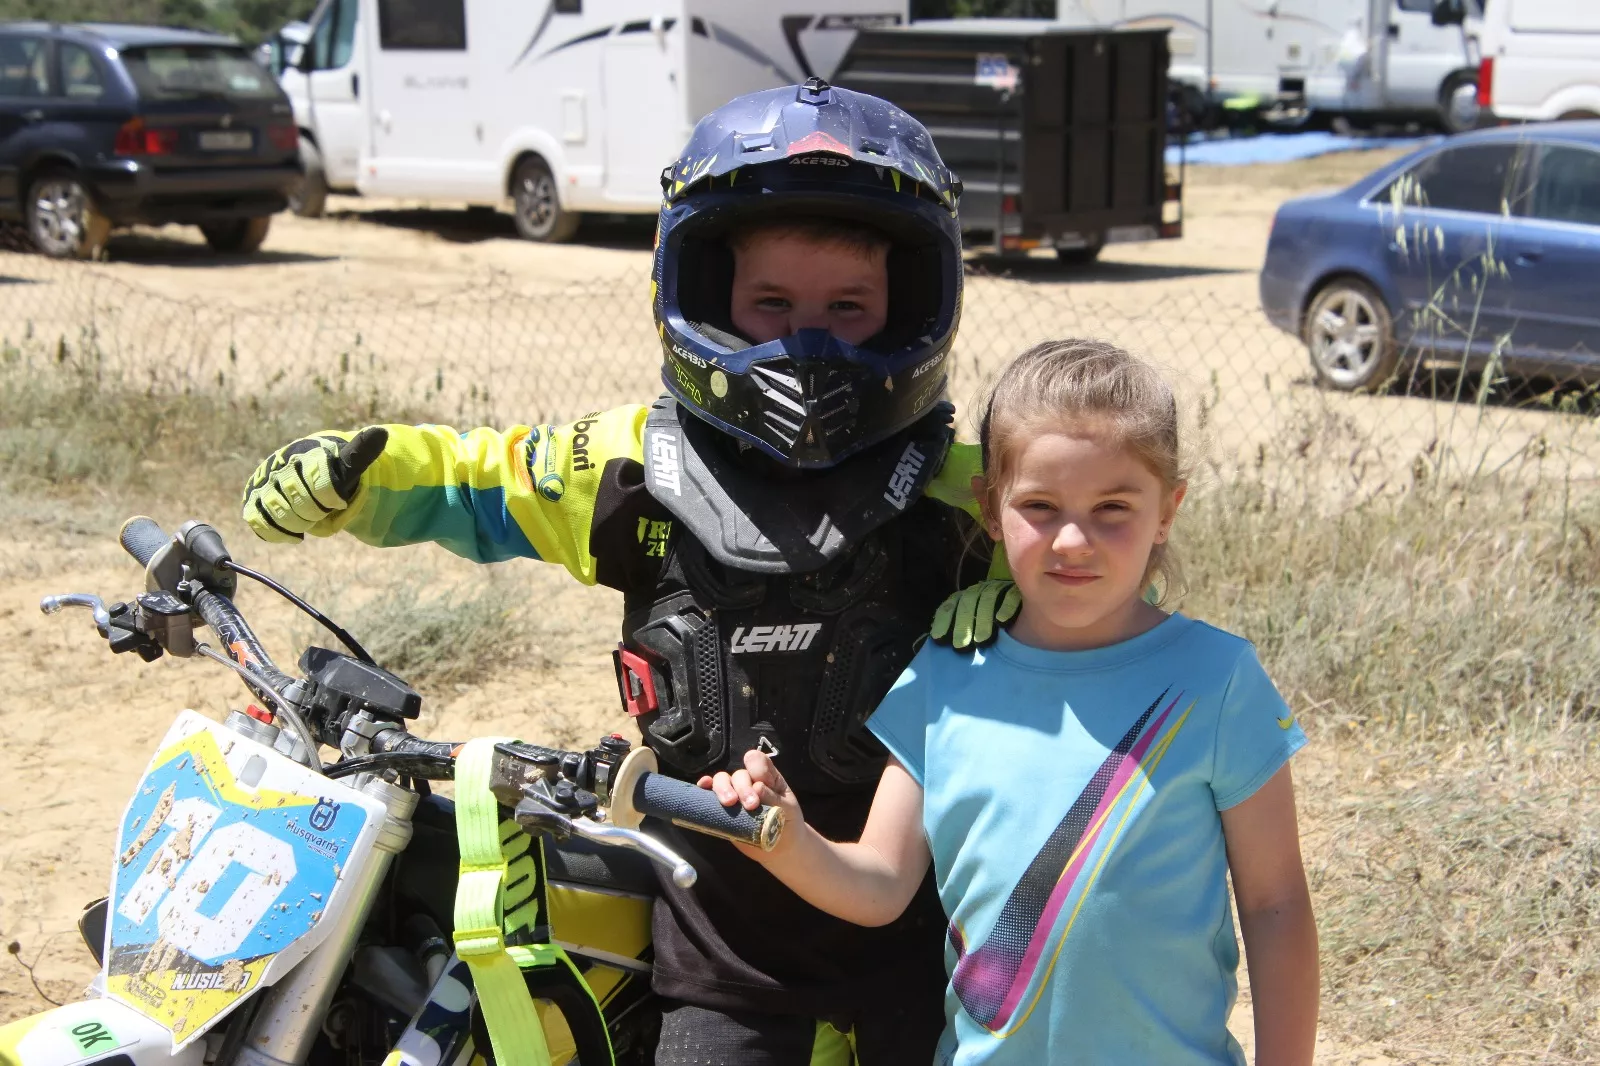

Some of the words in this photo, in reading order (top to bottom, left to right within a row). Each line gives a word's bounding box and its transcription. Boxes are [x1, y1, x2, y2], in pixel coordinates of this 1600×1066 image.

[789, 157, 850, 167] ACERBIS
[672, 344, 708, 369] ACERBIS
[651, 432, 681, 496] LEATT
[884, 441, 926, 511] LEATT
[646, 541, 666, 557] 74
[731, 622, 822, 654] LEATT
[286, 821, 340, 854] Husqvarna
[71, 1022, 113, 1050] OK
